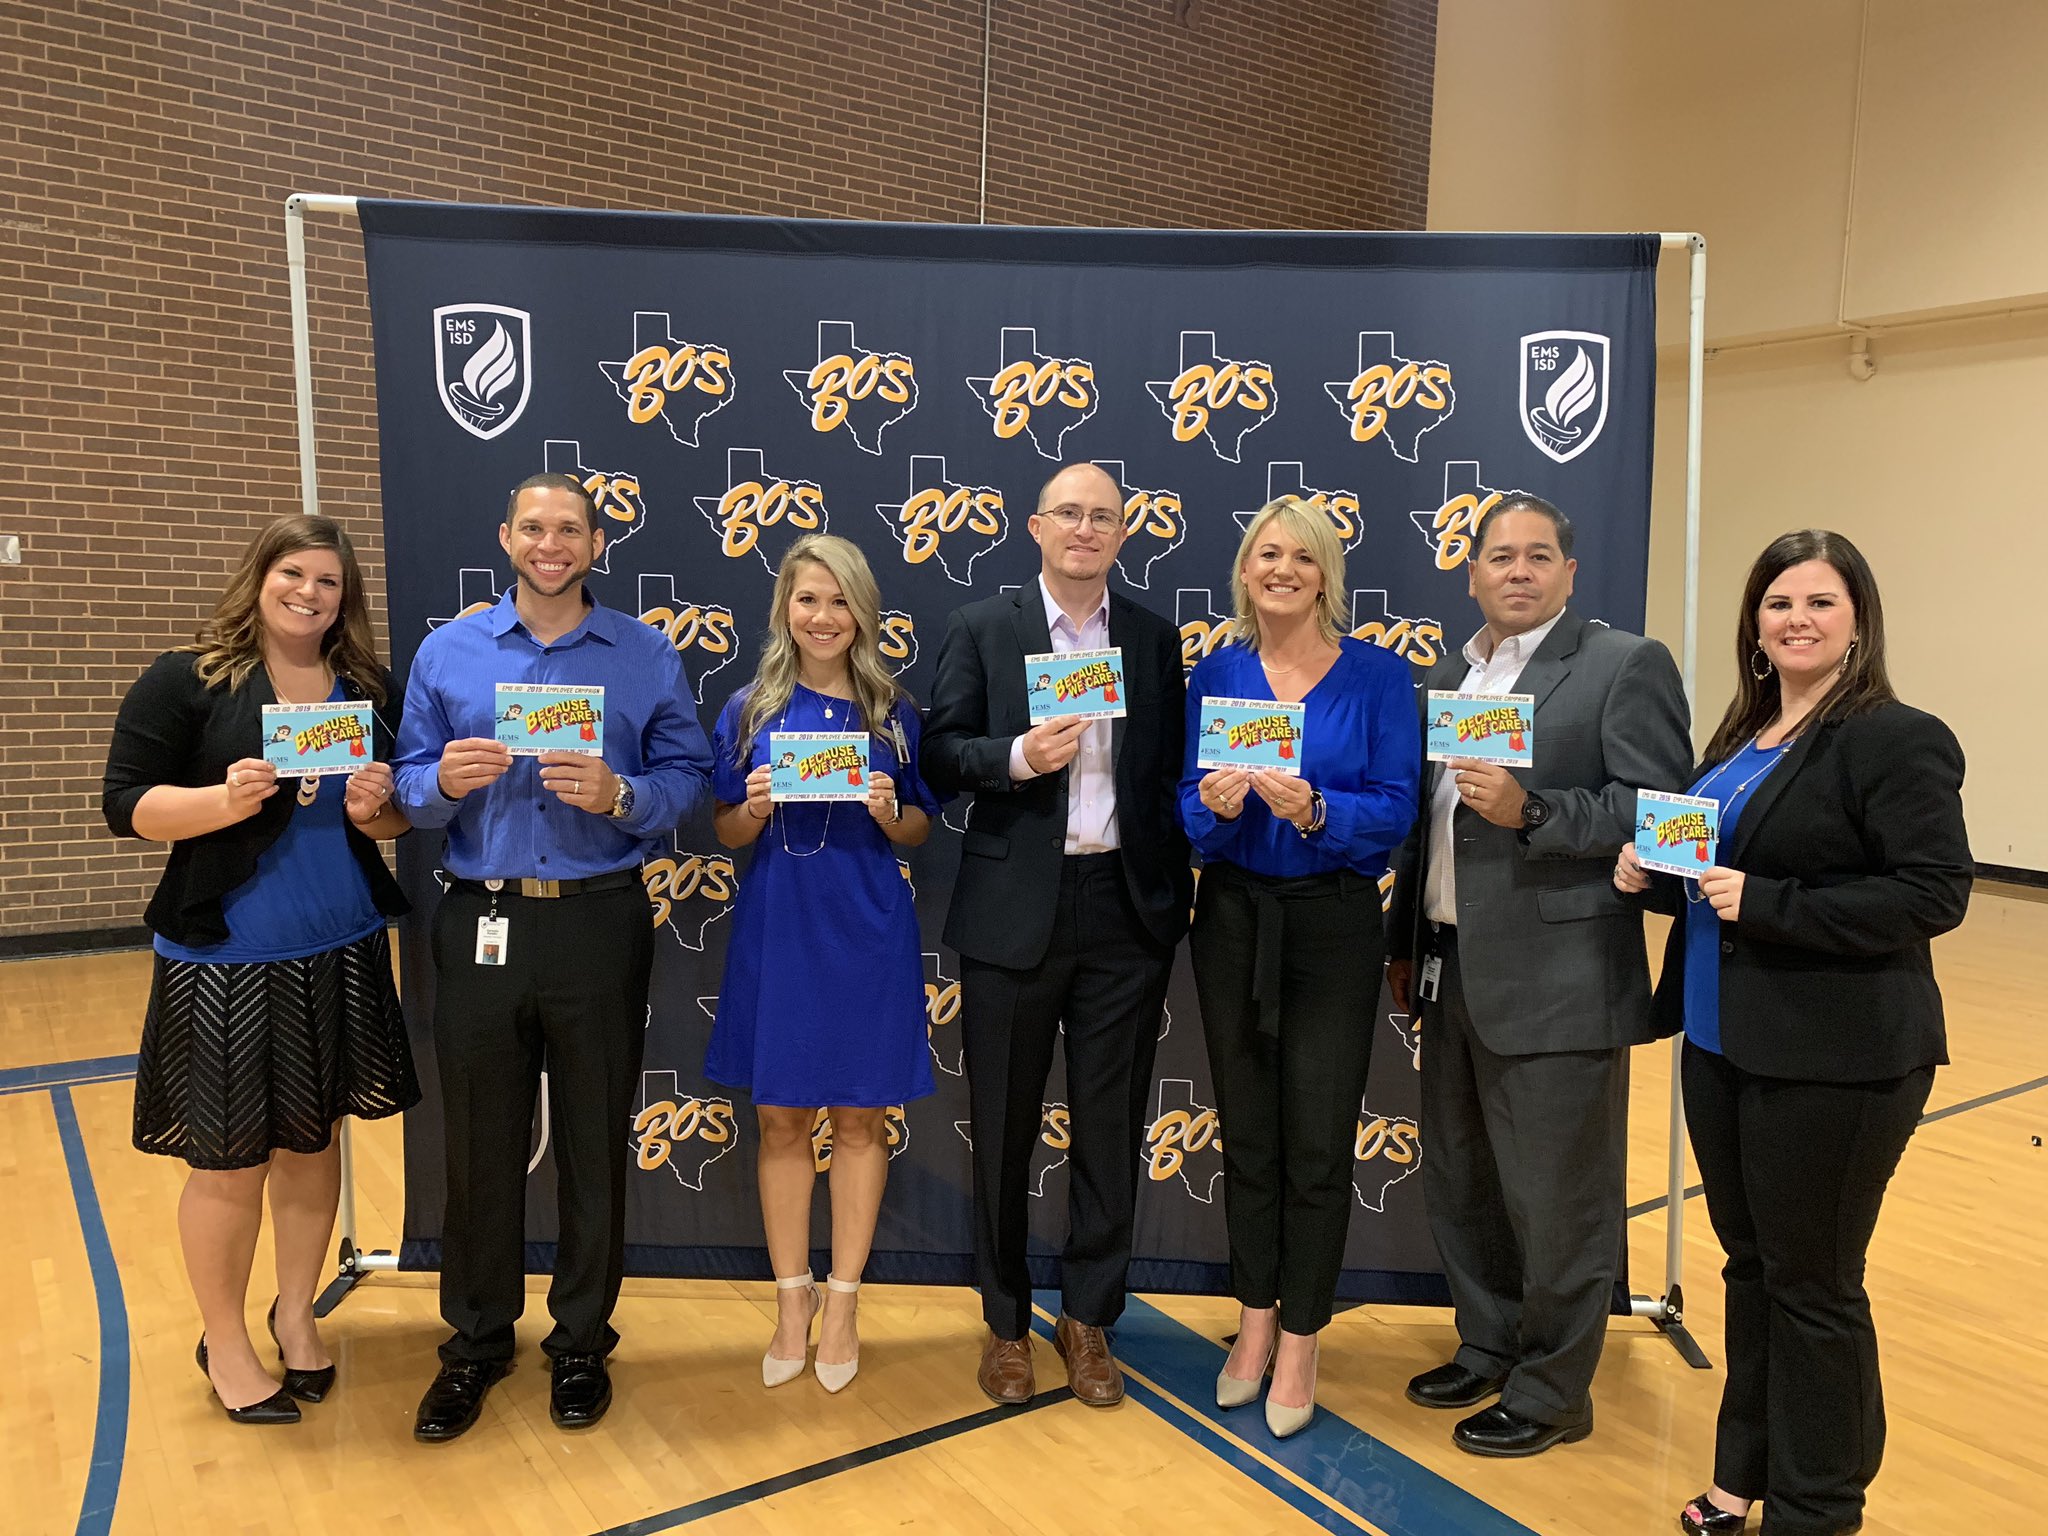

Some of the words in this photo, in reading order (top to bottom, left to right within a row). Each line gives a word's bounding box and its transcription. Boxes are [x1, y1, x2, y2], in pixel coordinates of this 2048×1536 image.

[446, 319, 476, 332] EMS
[450, 332, 473, 345] ISD
[1531, 346, 1560, 358] EMS
[1534, 359, 1557, 371] ISD
[1055, 661, 1110, 703] BECAUSE
[1068, 681, 1088, 699] WE
[525, 698, 590, 735] BECAUSE
[541, 715, 562, 734] WE
[1456, 707, 1519, 742] BECAUSE
[294, 714, 358, 755] BECAUSE
[1228, 715, 1291, 750] BECAUSE
[1242, 732, 1262, 749] WE
[1471, 724, 1491, 742] WE
[310, 733, 332, 752] WE
[798, 744, 856, 782] BECAUSE
[812, 762, 831, 779] WE
[1656, 812, 1706, 848] BECAUSE
[1667, 829, 1683, 848] WE
